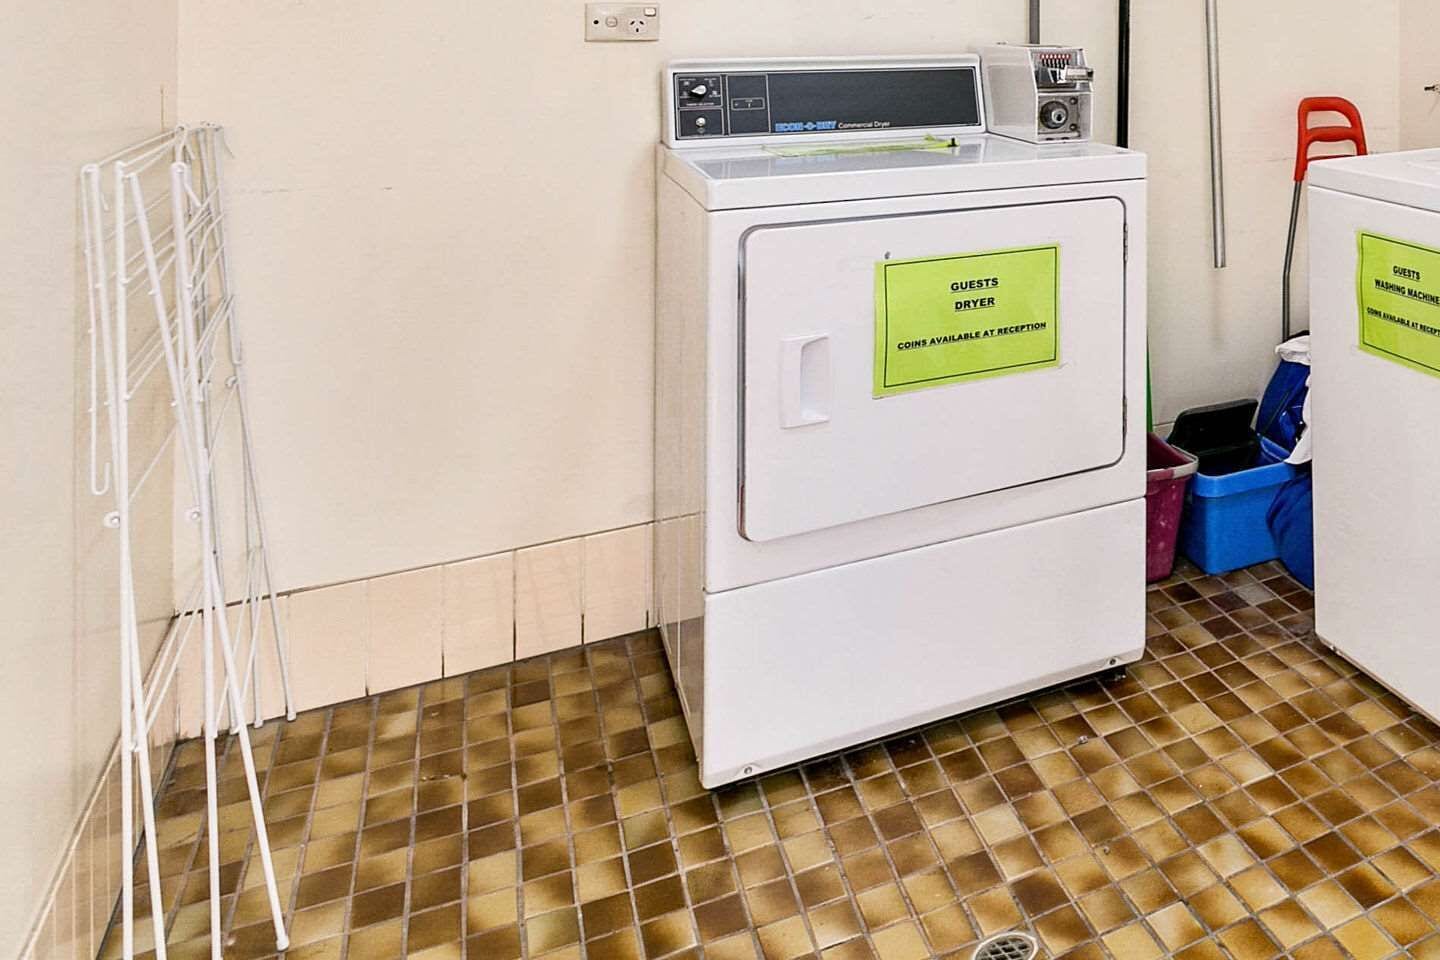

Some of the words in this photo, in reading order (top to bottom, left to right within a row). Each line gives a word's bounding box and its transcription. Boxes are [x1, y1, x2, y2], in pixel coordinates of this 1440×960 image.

[874, 120, 890, 129] Dryer
[1393, 266, 1421, 281] GUESTS
[951, 277, 999, 291] GUESTS
[1375, 279, 1406, 295] WASHING
[1407, 288, 1440, 305] MACHINE
[955, 297, 995, 311] DRYER
[1366, 306, 1382, 318] COINS
[1383, 312, 1410, 327] AVAILABLE
[1411, 321, 1419, 329] AT
[897, 339, 928, 350] COINS
[929, 331, 981, 346] AVAILABLE
[983, 328, 995, 337] AT
[997, 322, 1046, 336] RECEPTION
